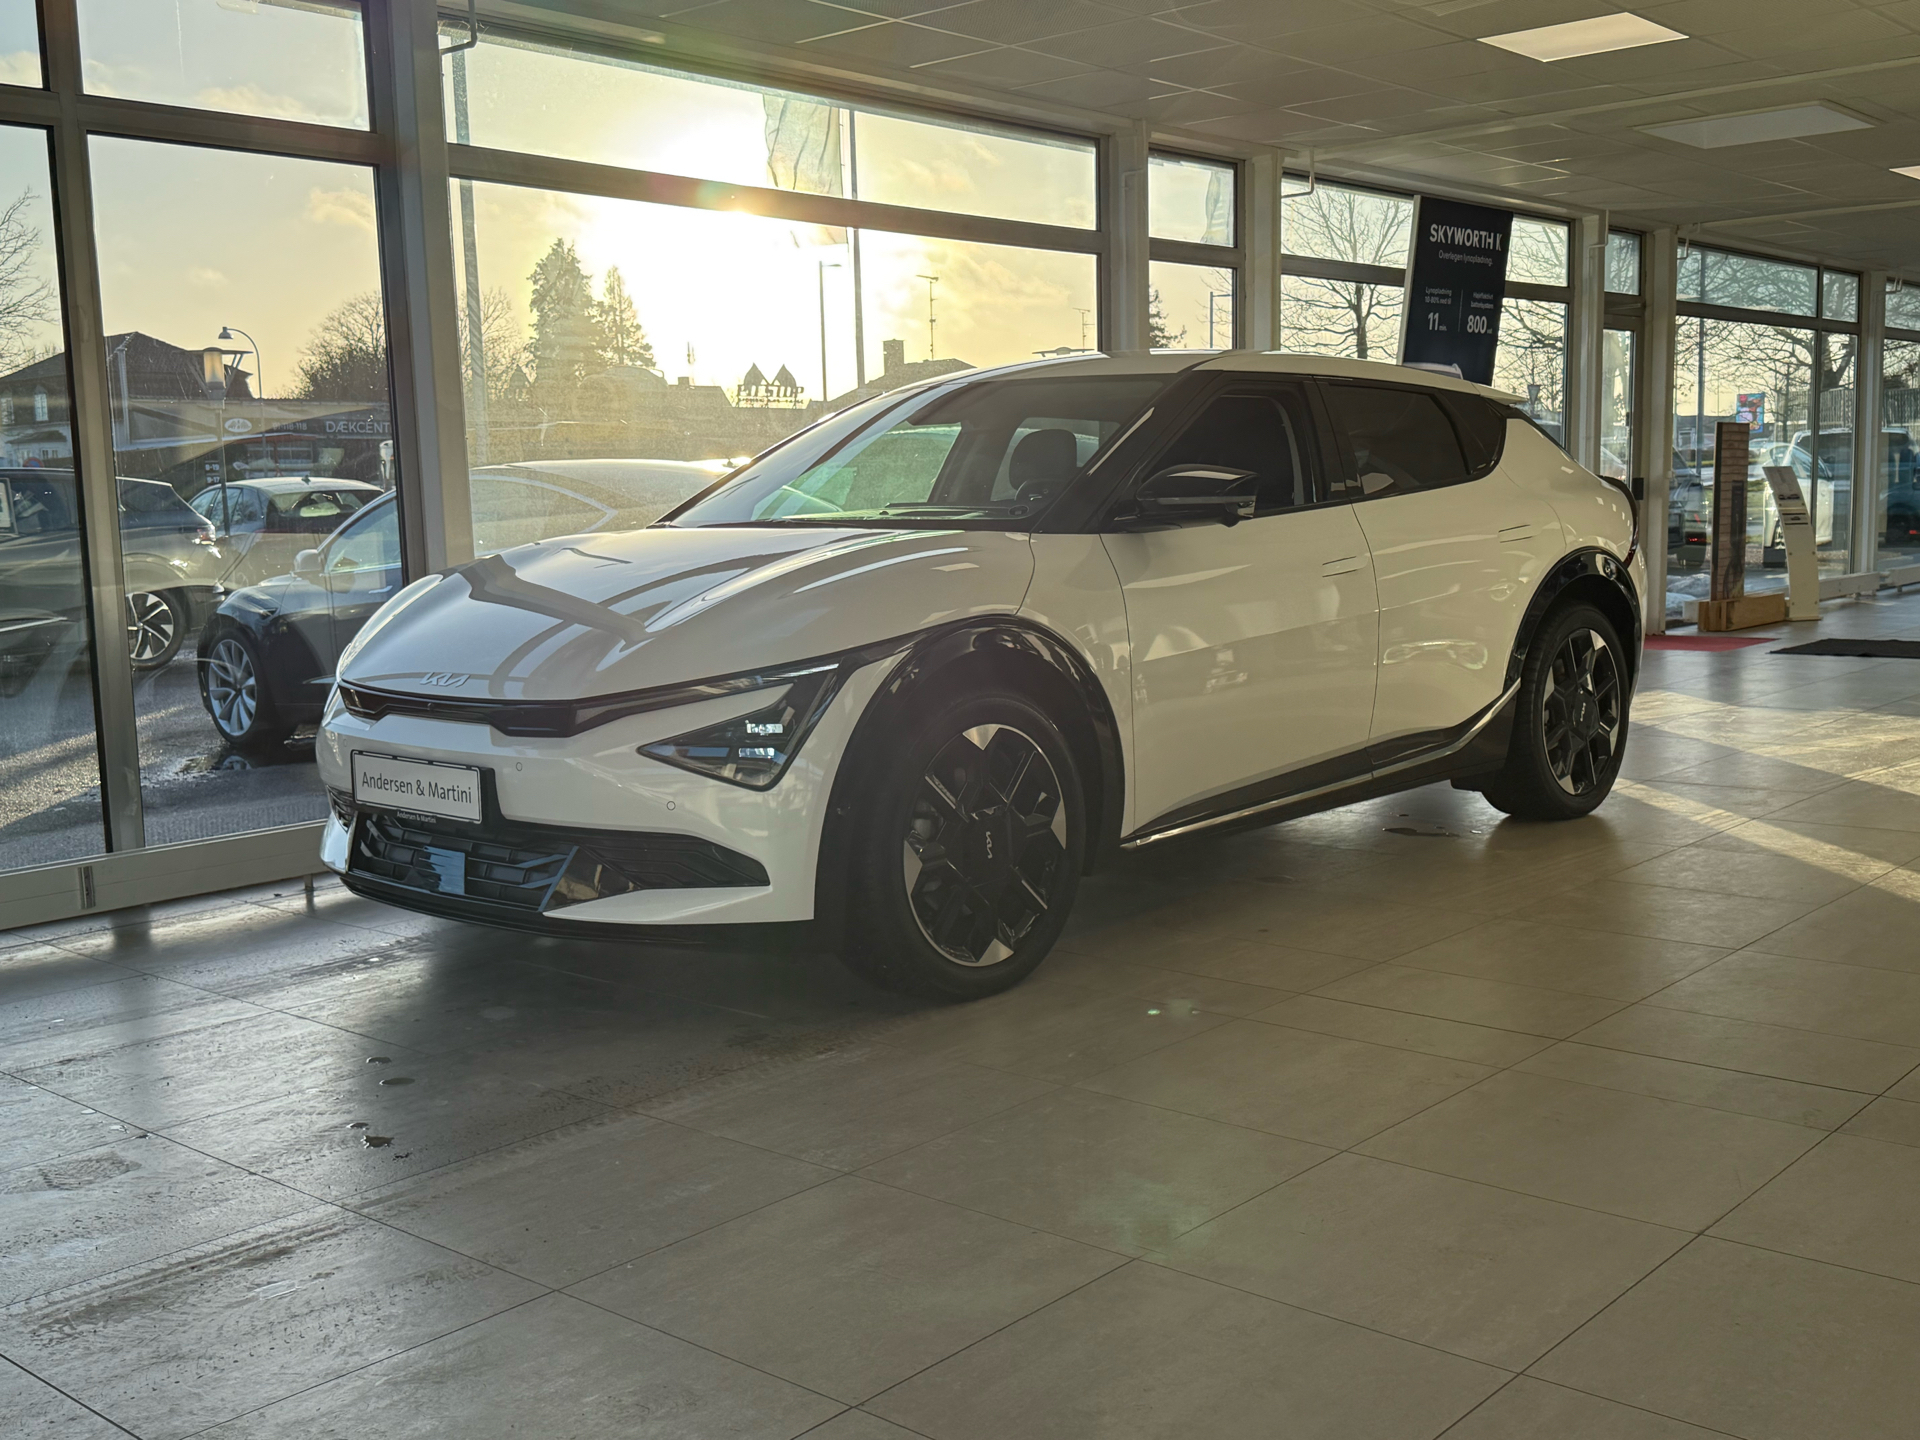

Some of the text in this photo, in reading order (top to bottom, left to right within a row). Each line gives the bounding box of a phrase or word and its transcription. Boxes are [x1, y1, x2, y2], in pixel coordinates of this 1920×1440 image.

[1429, 223, 1494, 250] SKYWORTH
[1438, 249, 1463, 262] Overlegen
[1427, 312, 1439, 331] 11
[1466, 314, 1487, 334] 800
[419, 671, 471, 688] KIA
[361, 771, 472, 804] Andersen & Martini
[396, 810, 416, 820] Andersen
[420, 815, 437, 824] Martini
